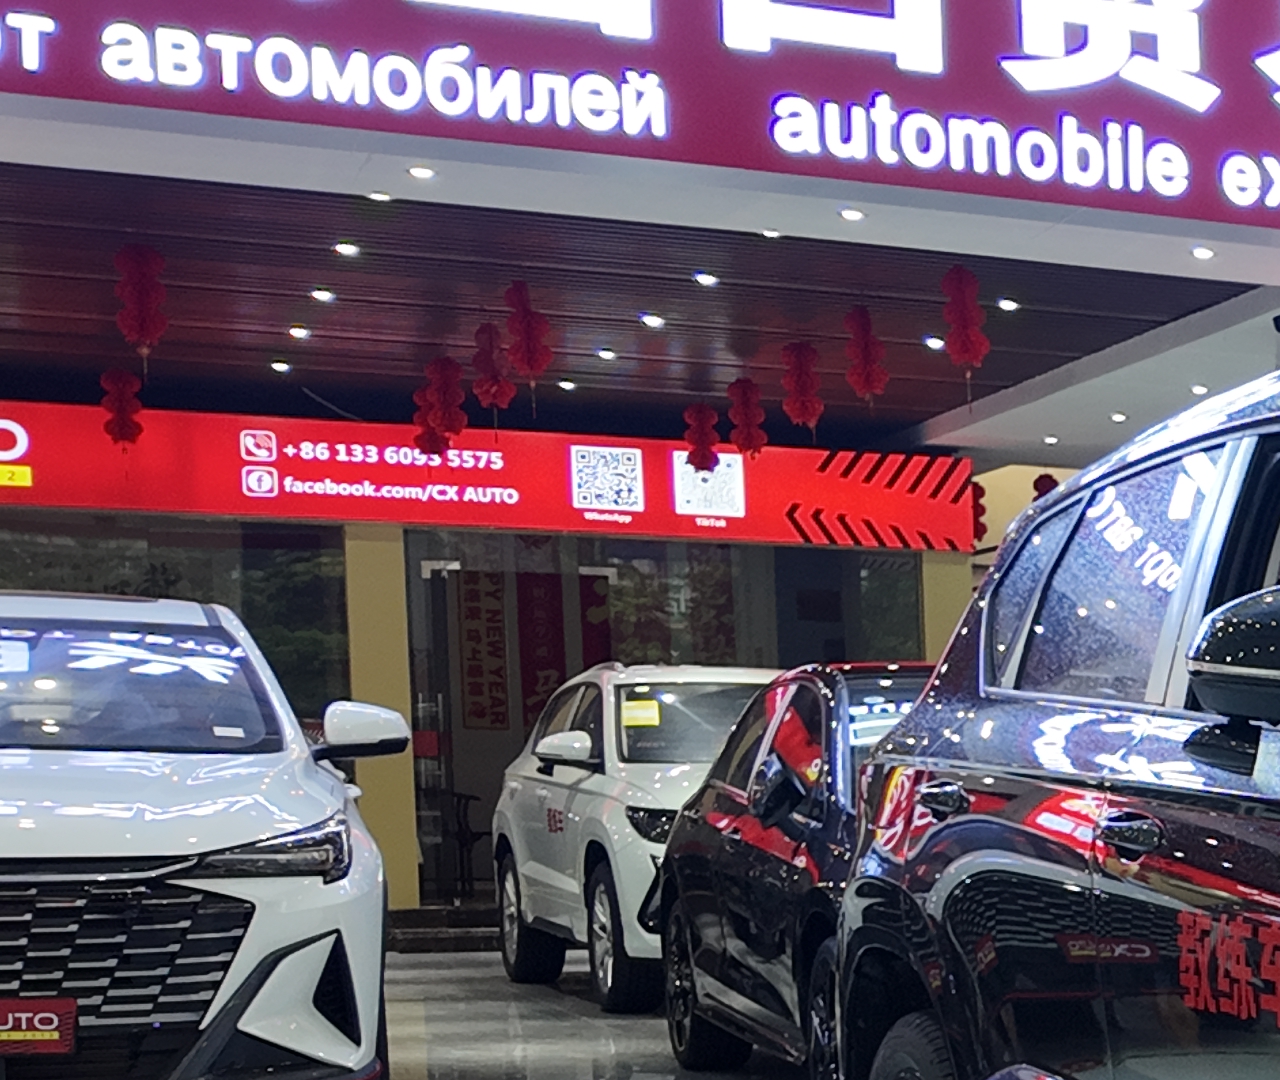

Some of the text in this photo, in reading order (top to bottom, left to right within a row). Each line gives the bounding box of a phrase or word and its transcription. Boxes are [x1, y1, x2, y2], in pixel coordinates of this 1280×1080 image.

[0, 12, 668, 137] т автомобилей
[771, 93, 1189, 197] automobile
[282, 441, 330, 461] +86
[335, 443, 379, 465] 133
[447, 449, 505, 471] 5575
[283, 476, 520, 506] facebook.com/CX AUTO
[488, 609, 504, 660] NEW
[488, 666, 506, 725] YEAR
